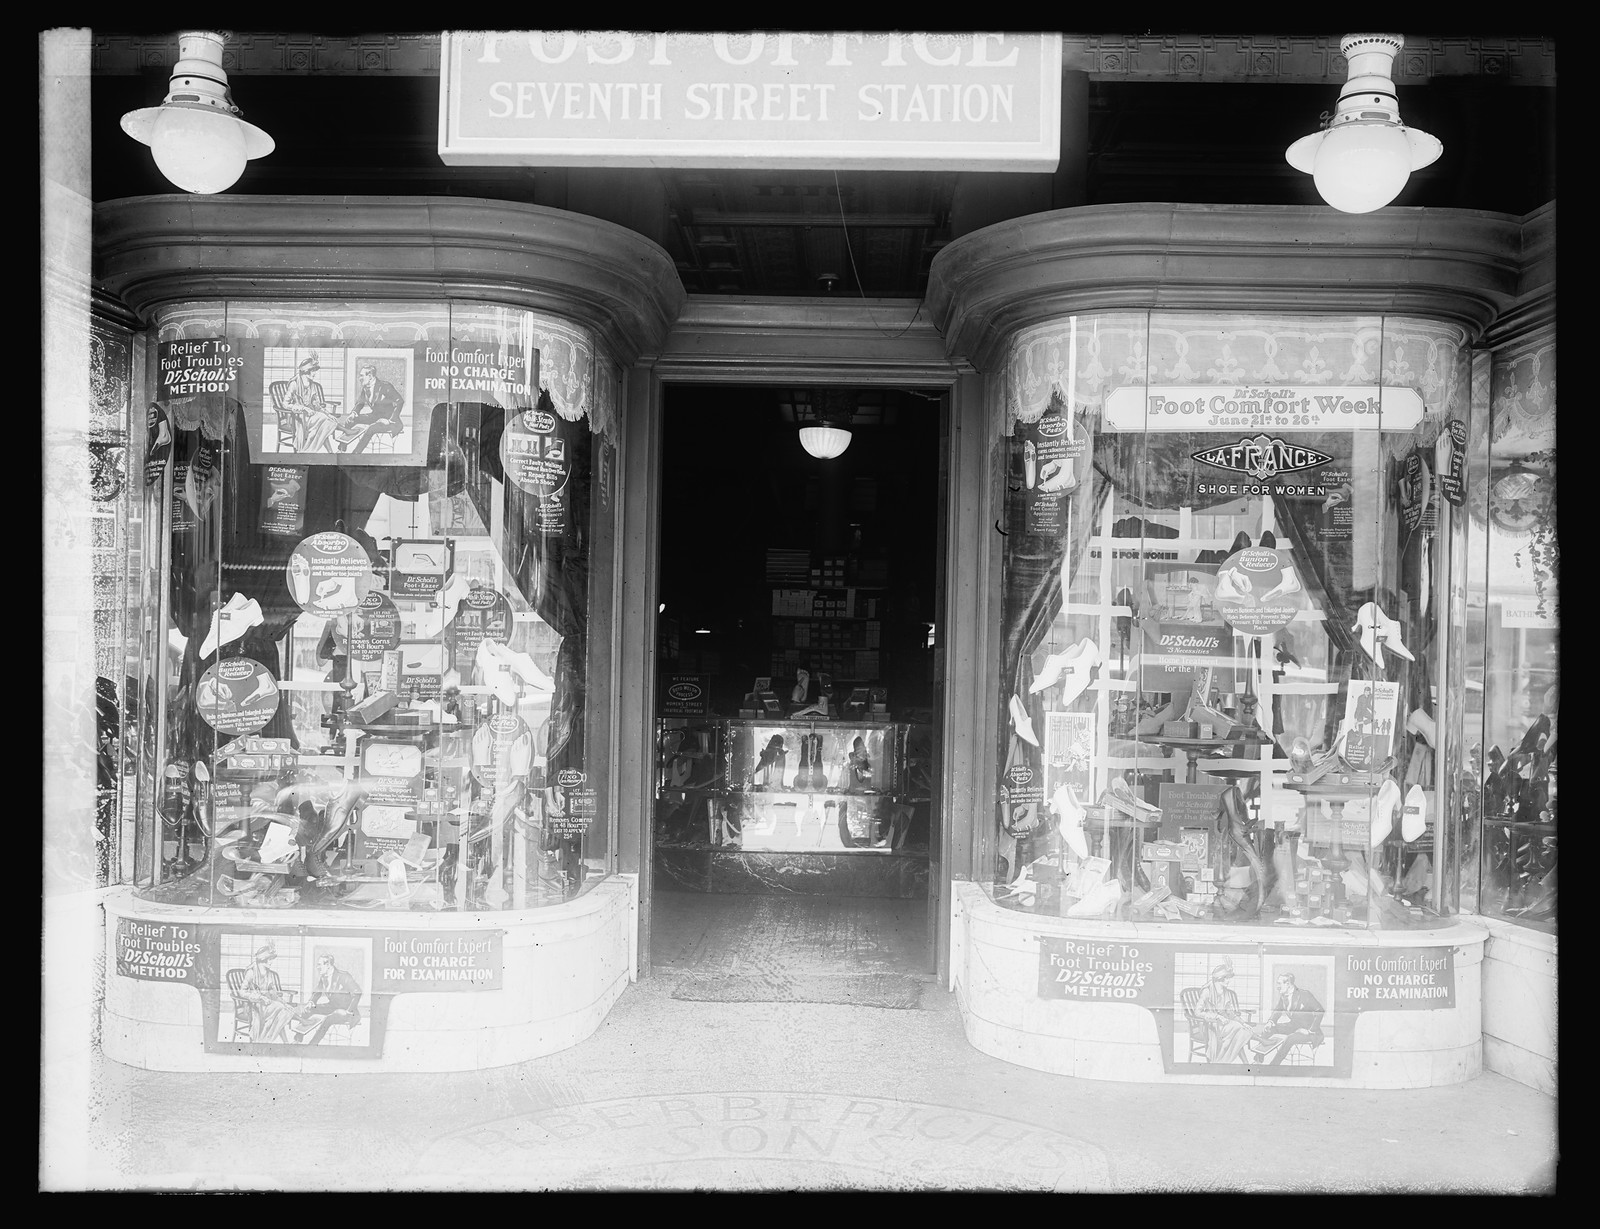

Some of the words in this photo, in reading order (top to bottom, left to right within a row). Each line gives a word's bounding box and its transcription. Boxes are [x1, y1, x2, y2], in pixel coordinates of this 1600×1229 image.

[488, 82, 663, 121] SEVENTH
[684, 83, 836, 121] STREET
[858, 84, 1014, 122] STATION
[170, 341, 210, 355] Relief
[213, 341, 231, 353] To
[161, 357, 181, 370] Foot
[185, 354, 244, 367] Troubes
[425, 348, 448, 363] Foot
[451, 347, 494, 365] Comfort
[498, 350, 530, 368] Exper
[441, 366, 458, 377] NO
[464, 366, 515, 381] CHARGE
[170, 382, 230, 395] METHOD
[425, 378, 446, 389] FOR
[452, 378, 531, 396] EXAMINATION
[1149, 396, 1205, 414] Foot
[1209, 395, 1310, 414] Comfort
[1314, 396, 1384, 414] Week
[1208, 415, 1249, 425] June
[1275, 415, 1289, 425] to
[1198, 485, 1237, 494] SHOE
[1243, 485, 1271, 495] FOR
[1275, 486, 1326, 496] WOMEN
[311, 557, 339, 565] Instantly
[1164, 664, 1177, 673] for
[1178, 664, 1191, 673] the
[130, 922, 166, 937] Relief
[170, 925, 188, 939] To
[120, 933, 141, 949] Foot
[144, 936, 201, 953] Troubles
[384, 937, 403, 953] Foot
[410, 937, 453, 954] Comfort
[457, 936, 492, 956] Expert
[1065, 942, 1115, 957] Relief
[1120, 944, 1139, 958] To
[140, 950, 195, 968] Scholl's
[400, 956, 417, 967] NO
[423, 956, 475, 967] CHARGE
[1050, 954, 1080, 969] Foot
[1084, 957, 1153, 973] Troubles
[1347, 955, 1370, 971] Foot
[1375, 955, 1416, 973] Comfort
[1420, 955, 1448, 974] Expert
[130, 964, 187, 979] METHOD
[384, 968, 405, 980] FOR
[411, 967, 493, 981] EXAMINATION
[1080, 970, 1146, 988] Scholl's
[1363, 974, 1382, 985] NO
[1388, 974, 1435, 986] CHARGE
[1064, 985, 1138, 999] METHOD
[1347, 987, 1370, 999] FOR
[1375, 986, 1449, 999] EXAMINATION
